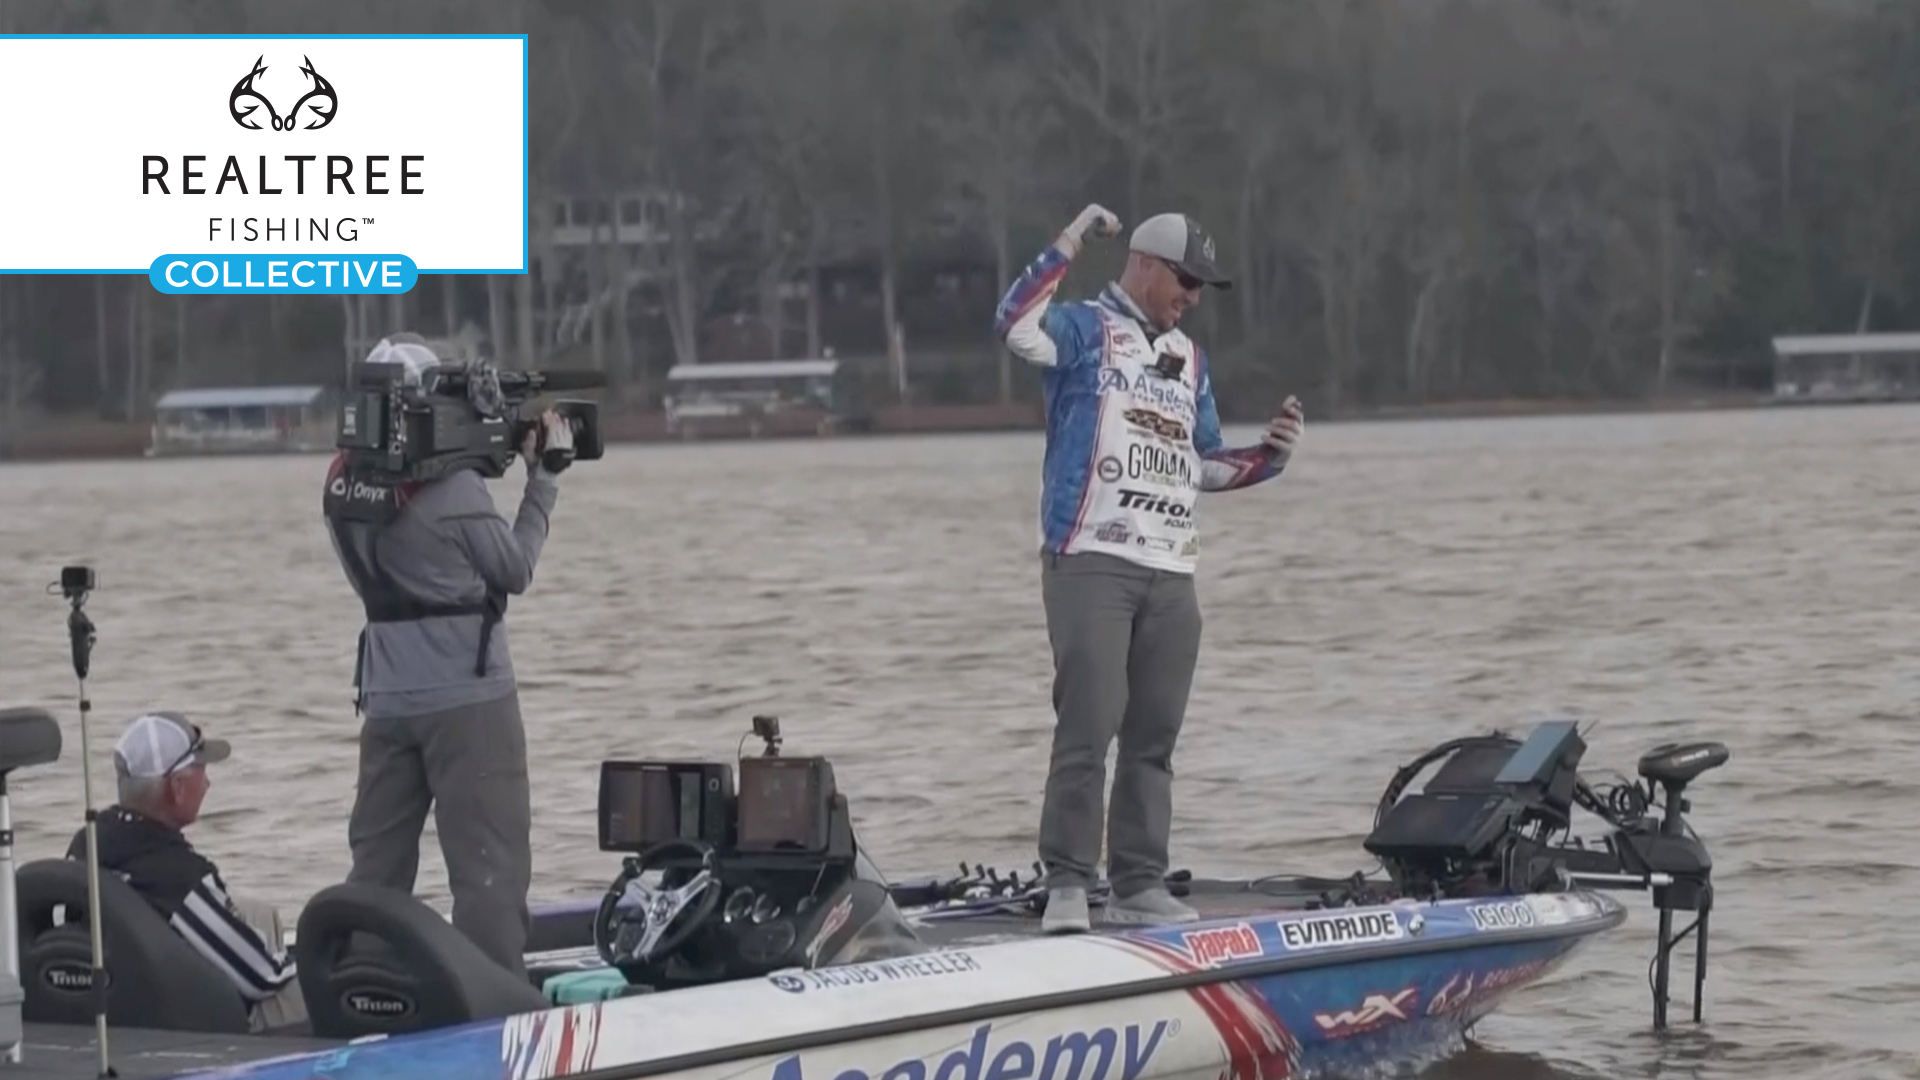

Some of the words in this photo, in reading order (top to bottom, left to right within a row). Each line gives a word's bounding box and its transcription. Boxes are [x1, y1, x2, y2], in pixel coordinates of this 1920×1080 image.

[354, 481, 388, 503] Onyx
[1281, 912, 1396, 945] EVINRUDE
[806, 963, 879, 991] JACOB
[880, 951, 981, 981] WHEELER
